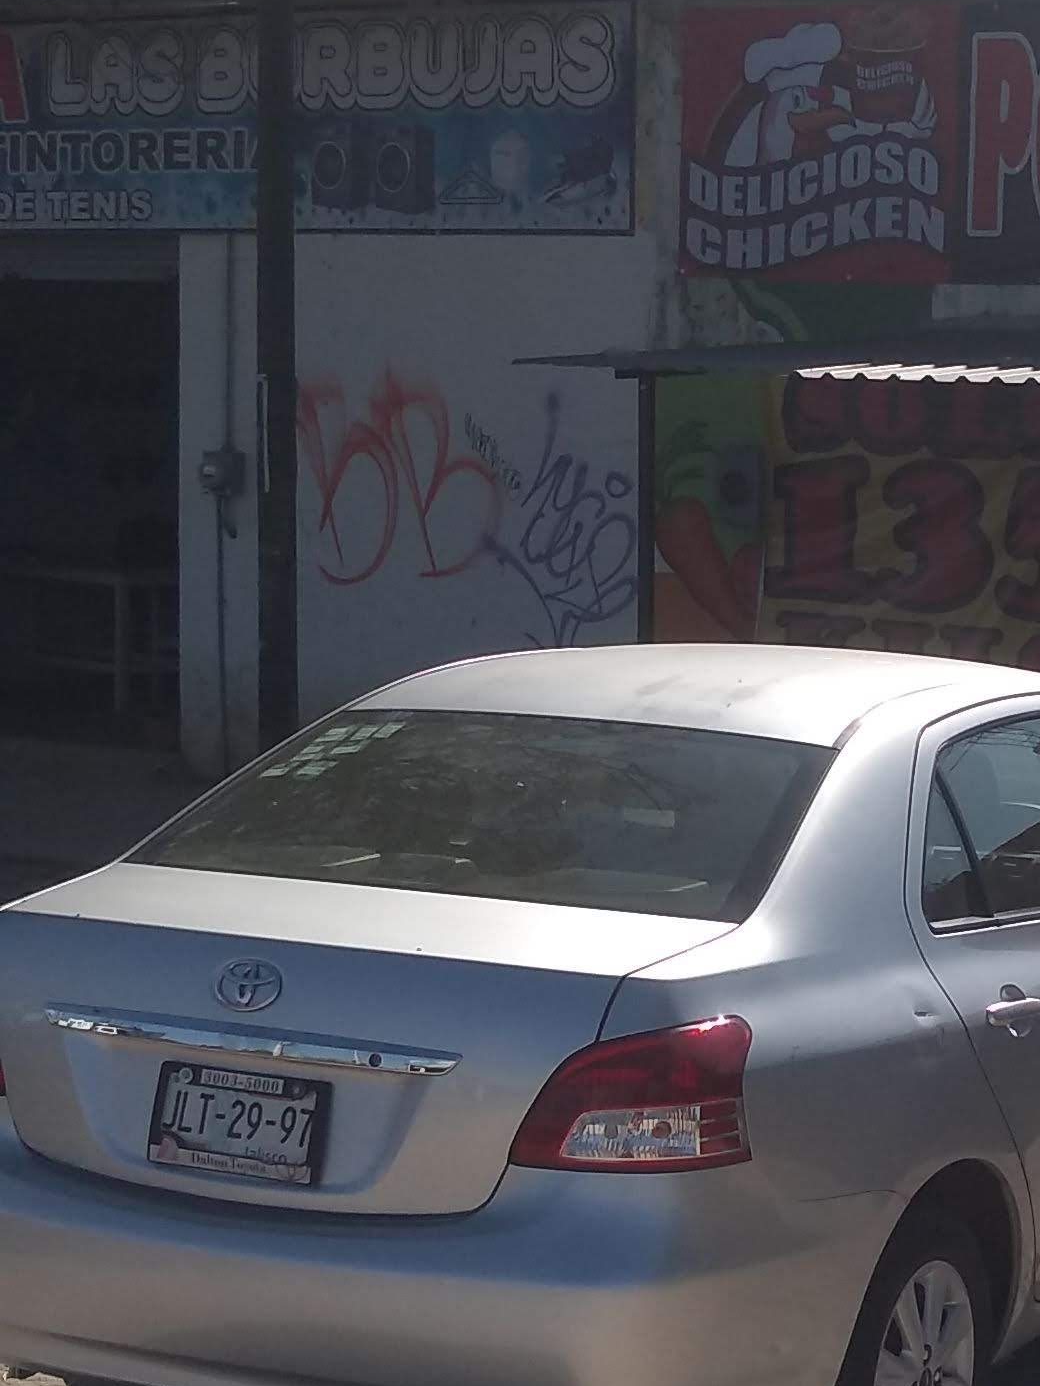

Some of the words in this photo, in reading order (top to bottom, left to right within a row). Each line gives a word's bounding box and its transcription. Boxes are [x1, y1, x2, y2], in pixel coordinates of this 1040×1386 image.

[47, 28, 186, 116] LAS
[0, 126, 258, 174] INTORERI
[687, 139, 940, 215] DELICIOSO
[47, 189, 153, 223] TENIS
[686, 194, 945, 272] CHICKEN
[162, 1090, 316, 1148] JLT-29-97
